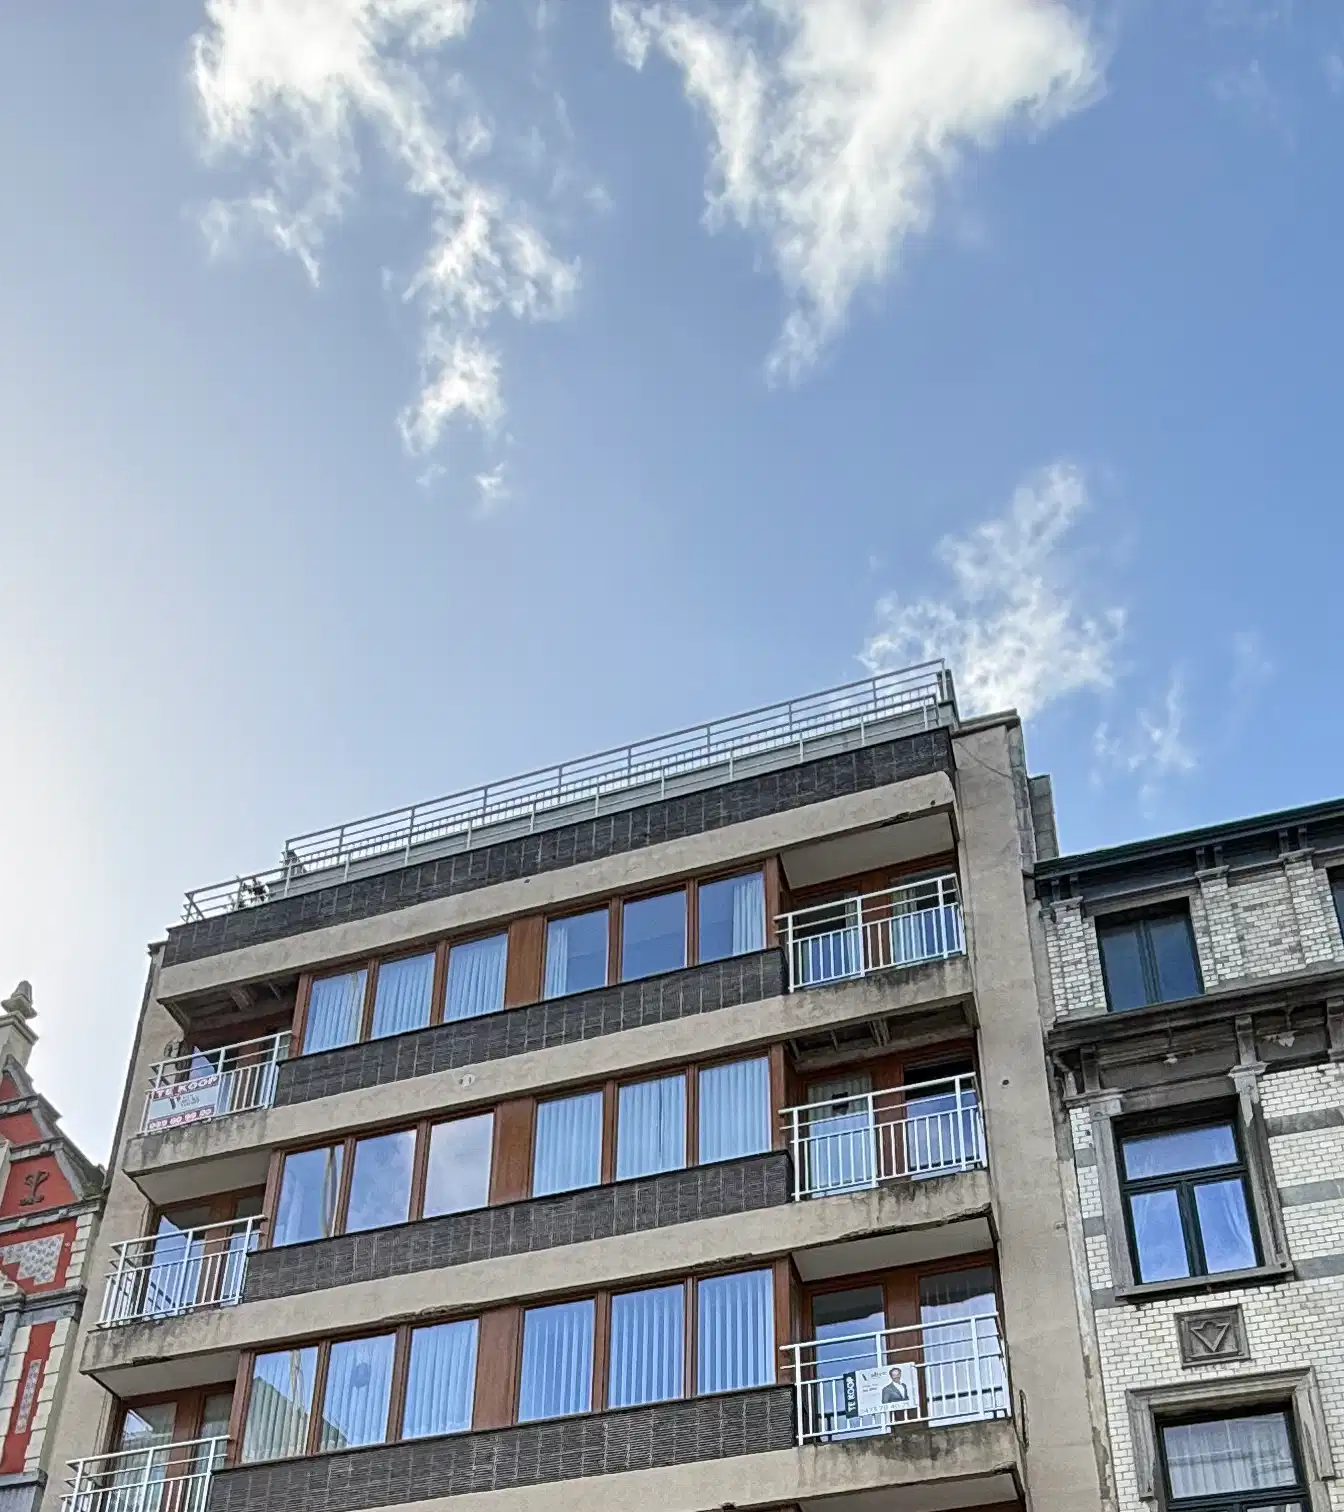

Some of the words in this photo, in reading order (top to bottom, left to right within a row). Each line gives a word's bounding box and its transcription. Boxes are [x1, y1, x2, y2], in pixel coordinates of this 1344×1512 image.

[156, 1089, 173, 1098] TE
[177, 1075, 218, 1093] KOOP
[846, 1376, 856, 1401] KOOP
[847, 1400, 856, 1413] TE
